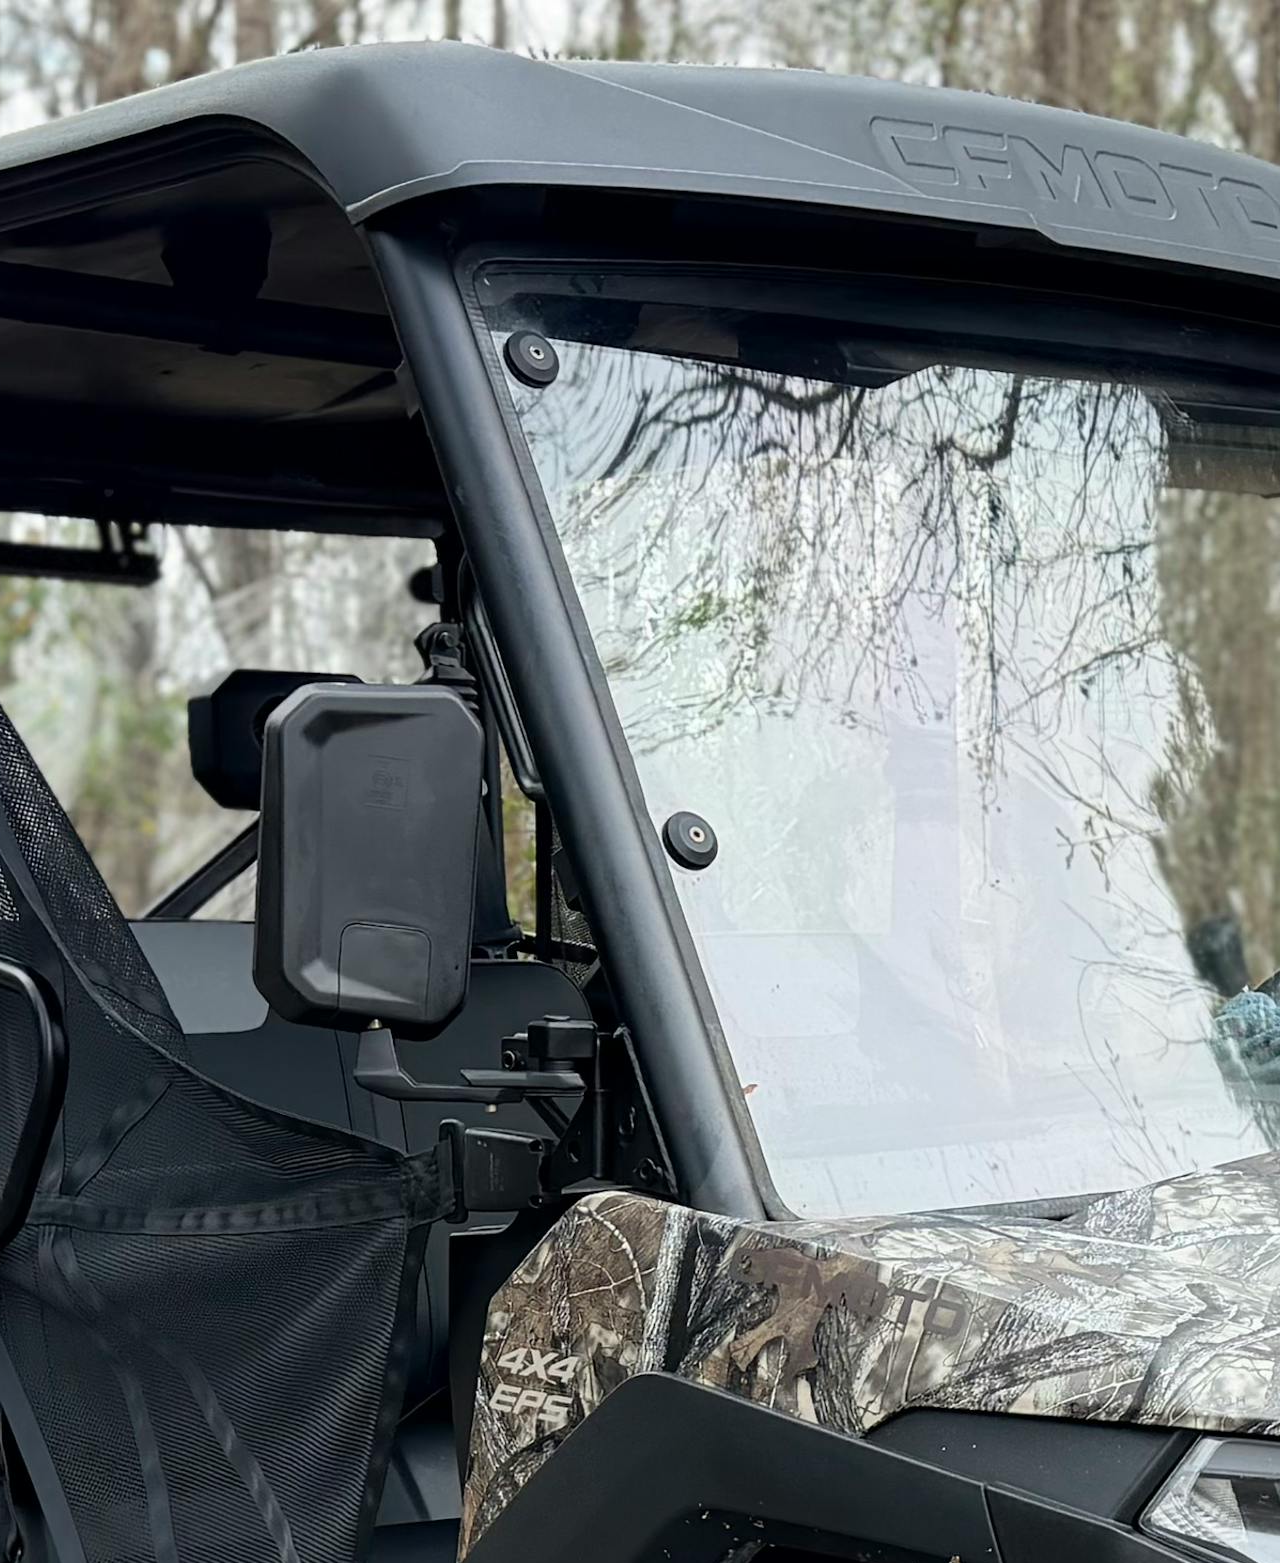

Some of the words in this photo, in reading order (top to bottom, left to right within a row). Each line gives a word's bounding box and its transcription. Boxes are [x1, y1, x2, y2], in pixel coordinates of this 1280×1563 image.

[732, 1246, 968, 1336] CFMOTO
[497, 1347, 580, 1384] 4X4
[488, 1384, 574, 1425] EPS
